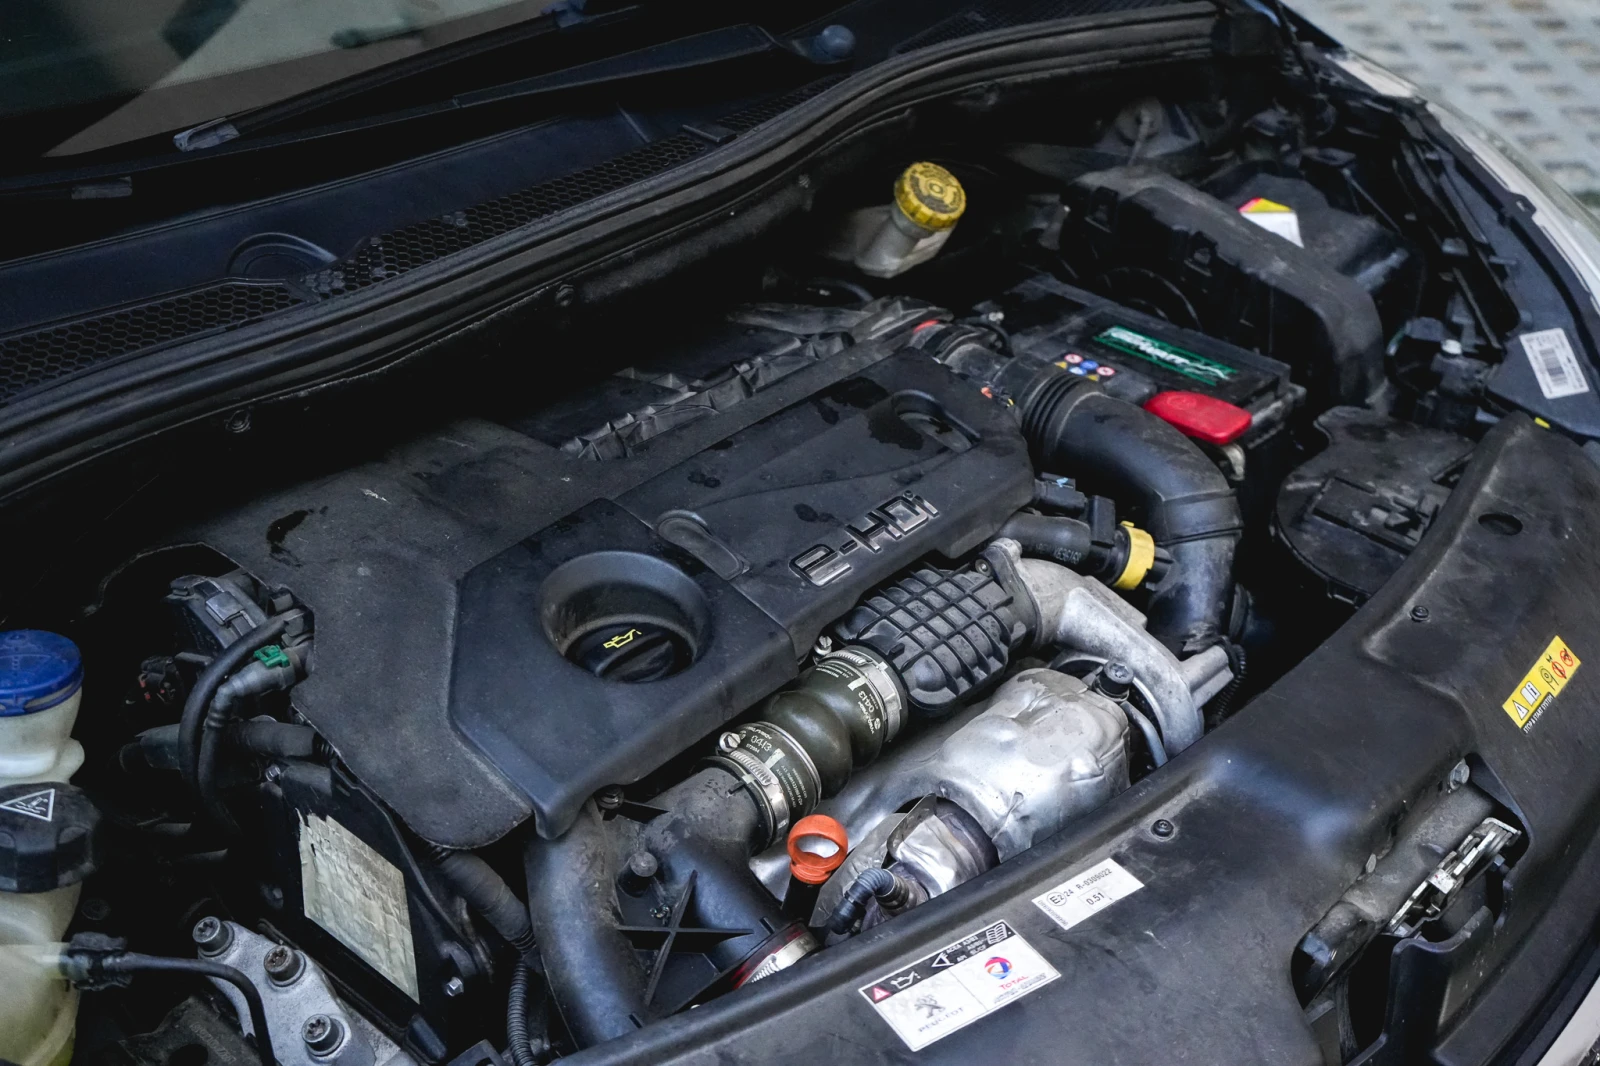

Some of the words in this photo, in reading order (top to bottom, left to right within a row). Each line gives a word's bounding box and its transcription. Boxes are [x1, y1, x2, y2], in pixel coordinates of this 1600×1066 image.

[858, 690, 875, 712] 0413
[750, 735, 772, 752] 0413
[1085, 892, 1105, 906] 0.51
[998, 974, 1030, 991] TOTAL
[917, 1005, 965, 1034] PEUGEOT
